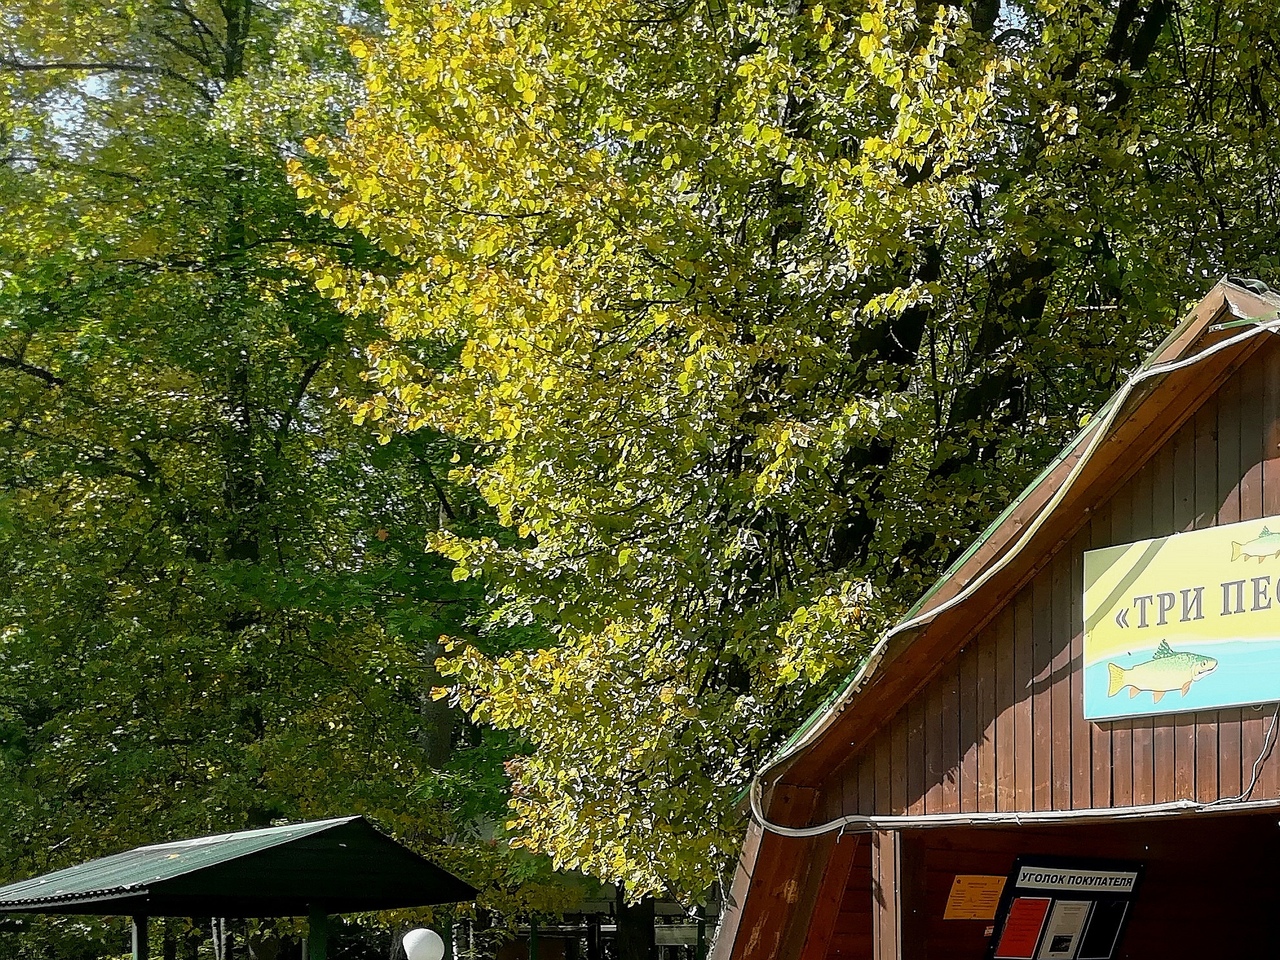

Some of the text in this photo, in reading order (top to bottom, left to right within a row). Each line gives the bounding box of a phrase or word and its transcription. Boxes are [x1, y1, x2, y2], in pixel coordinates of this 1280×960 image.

[1115, 586, 1206, 629] «ТРИ
[1020, 872, 1133, 887] УГОЛОК ПОКУПАТЕЛЯ
